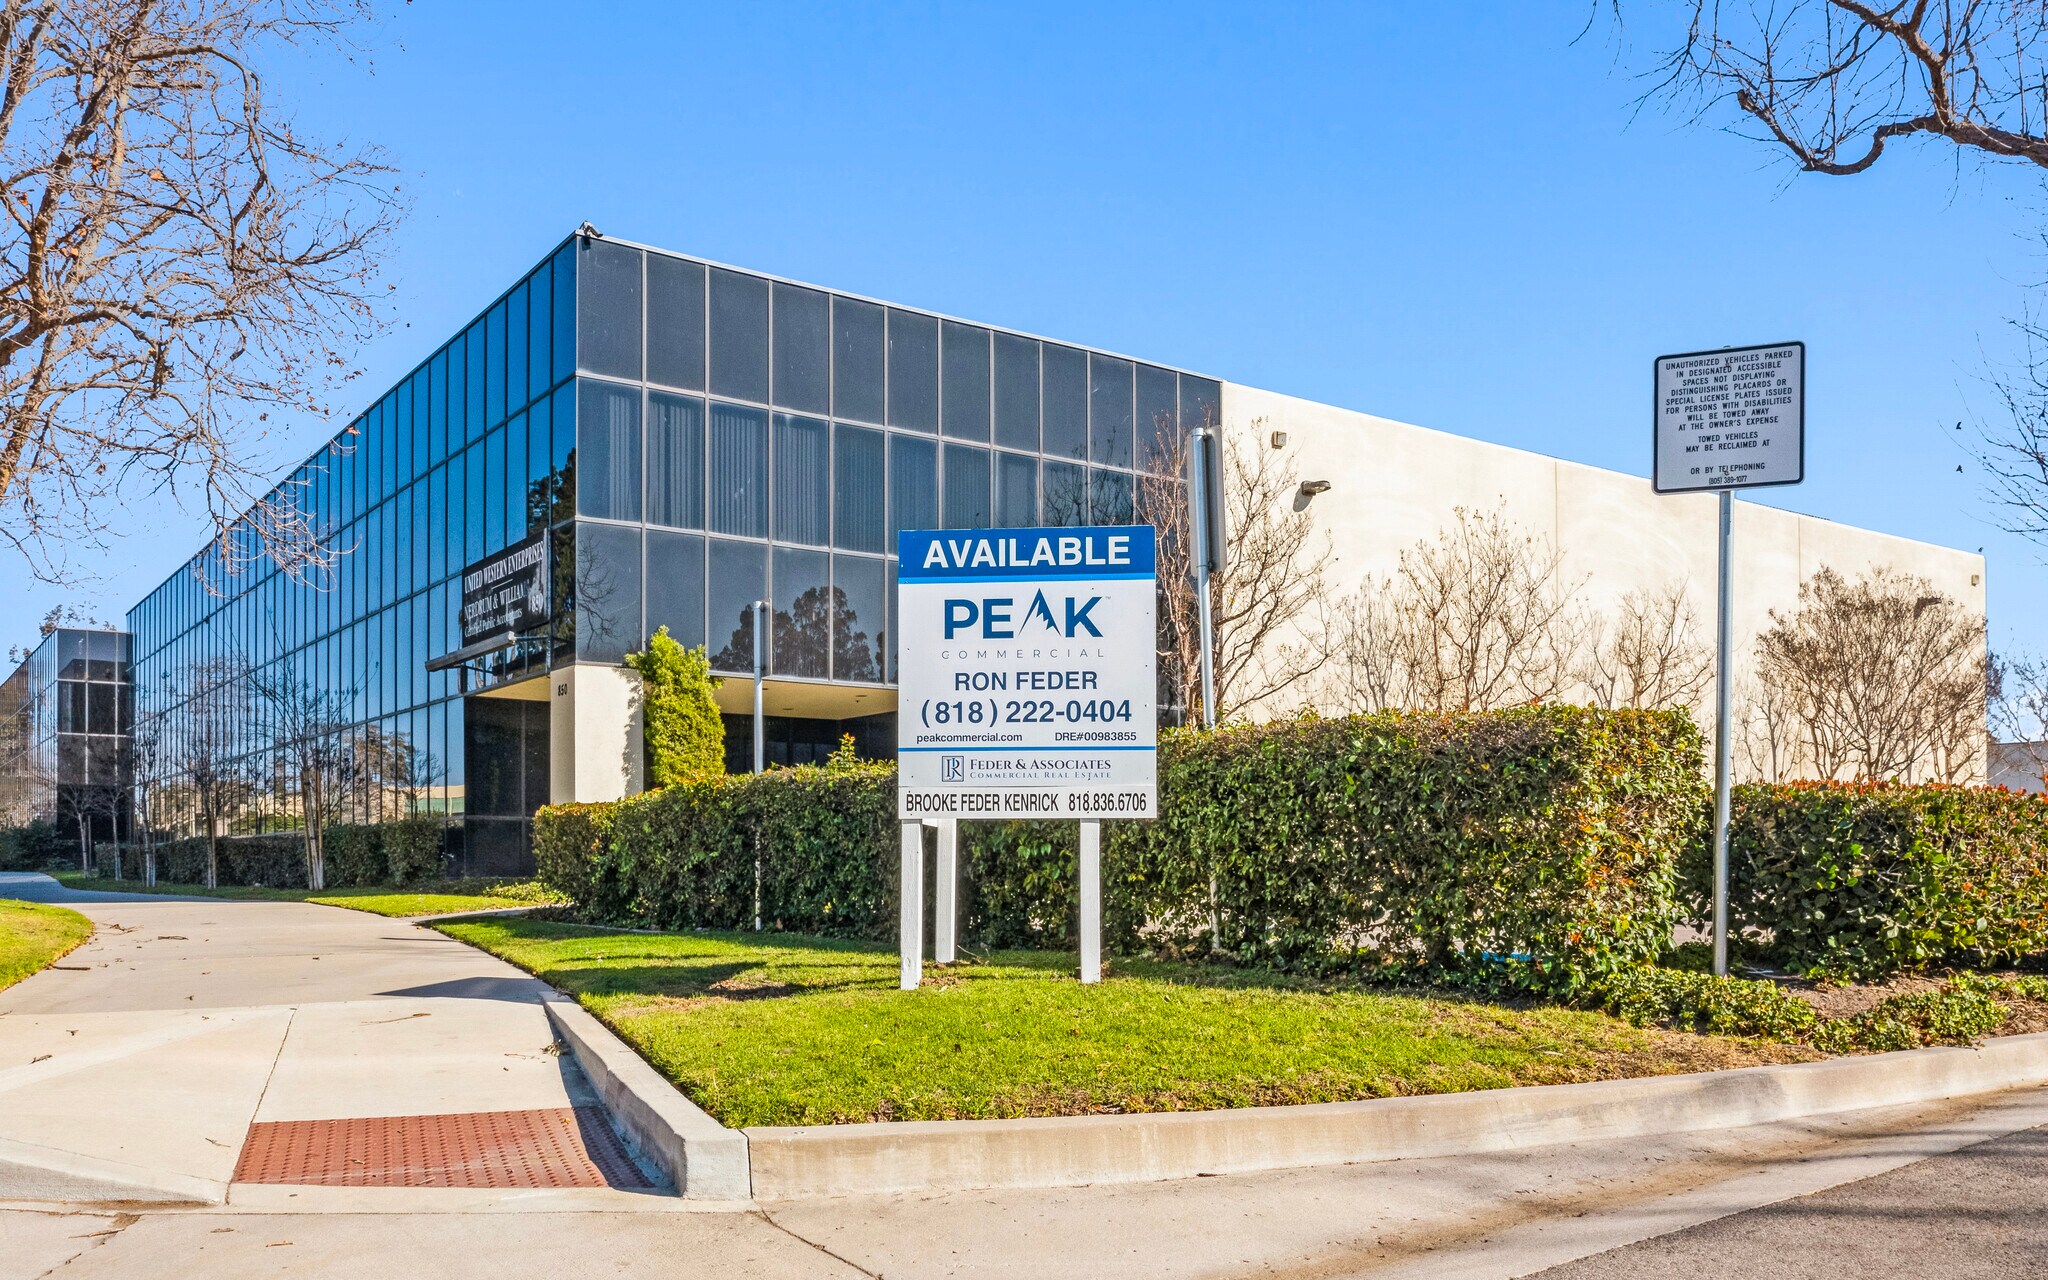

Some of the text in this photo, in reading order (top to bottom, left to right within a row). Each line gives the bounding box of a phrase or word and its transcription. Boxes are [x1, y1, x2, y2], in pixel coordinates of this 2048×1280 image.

[1666, 350, 1792, 370] UNAUTHORIZED VEHICLES PARKED
[1689, 366, 1732, 377] DESIGNATED
[1738, 361, 1781, 371] ACCESSIBLE
[1682, 378, 1708, 386] SPACES
[1732, 371, 1775, 381] DISPLAYING
[1672, 384, 1728, 396] DISTINGUISHING
[1734, 381, 1772, 390] PLACARDS
[1666, 388, 1792, 406] SPECIAL LICENSE PLATES ISSUED
[1685, 404, 1718, 412] PERSONS
[1722, 402, 1739, 410] WITH
[1744, 396, 1792, 408] DISABILITIES
[1723, 410, 1746, 418] TOWED
[1752, 408, 1770, 416] AWAY
[1709, 420, 1741, 428] OWNER'S
[1747, 416, 1778, 425] EXPENSE
[1725, 432, 1758, 440] VEHICLES
[1718, 441, 1757, 450] RECLAIMED
[922, 536, 1130, 568] AVAILABLE
[464, 541, 544, 594] UNITED WESTERN ENTERPRISES
[493, 594, 498, 609] &
[532, 592, 544, 612] 850
[944, 588, 1104, 640] PEAK
[942, 648, 1104, 660] COMMERCIAL
[955, 670, 1098, 690] RON FEDER
[558, 683, 568, 696] 850
[922, 699, 1132, 728] (818) 222-0404
[916, 732, 1022, 744] peakcommercial.com
[1055, 732, 1137, 742] DRE#00983855
[1016, 758, 1026, 770] &
[906, 794, 1146, 812] BROOKE FEDER KENRICK 818.836.6706
